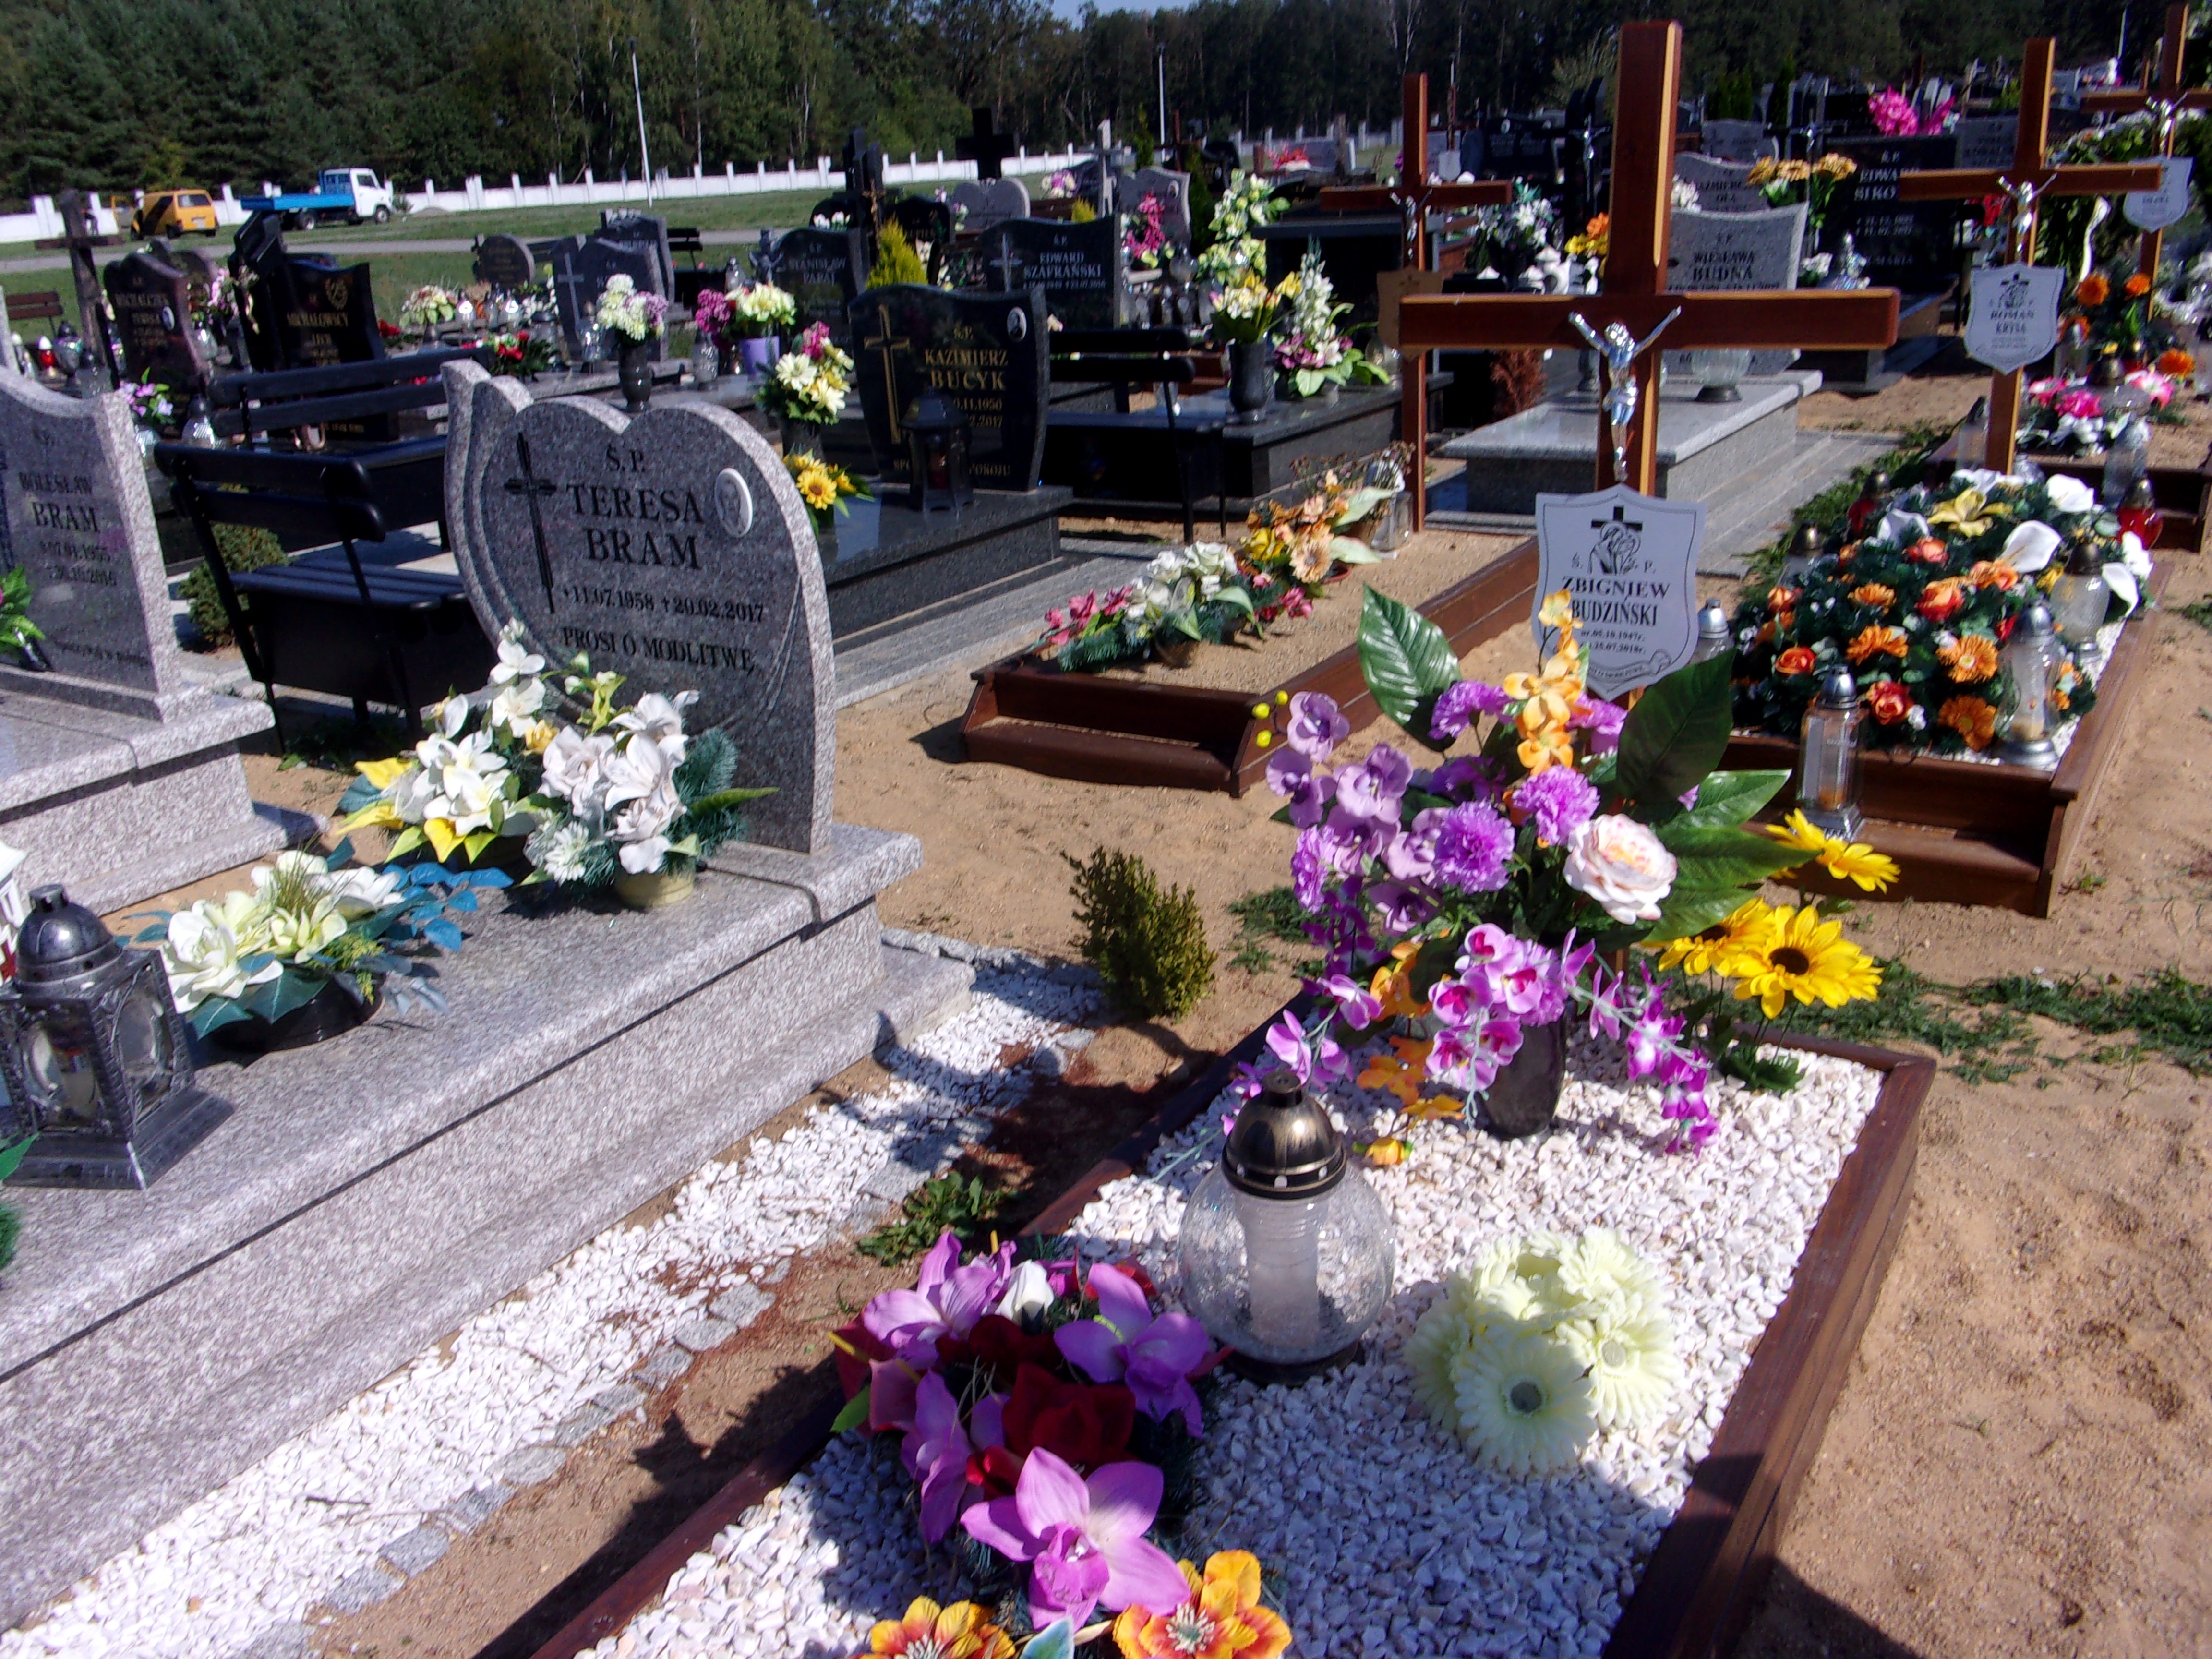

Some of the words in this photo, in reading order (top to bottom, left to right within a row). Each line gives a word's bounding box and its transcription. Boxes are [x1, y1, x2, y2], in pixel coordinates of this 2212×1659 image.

[1860, 167, 1920, 183] EDWA
[1039, 251, 1085, 264] EDWARD
[924, 349, 1009, 366] KAZIMIERZ
[931, 369, 1006, 391] BUCYK
[566, 482, 705, 524] TERESA
[32, 501, 100, 533] BRAM
[582, 529, 702, 570] BRAM
[1562, 576, 1671, 599] ZBIGNIEW
[1571, 595, 1658, 626] BUDZIŃSKI
[563, 626, 617, 653] PROSI
[641, 635, 758, 675] MODLITWĘ
